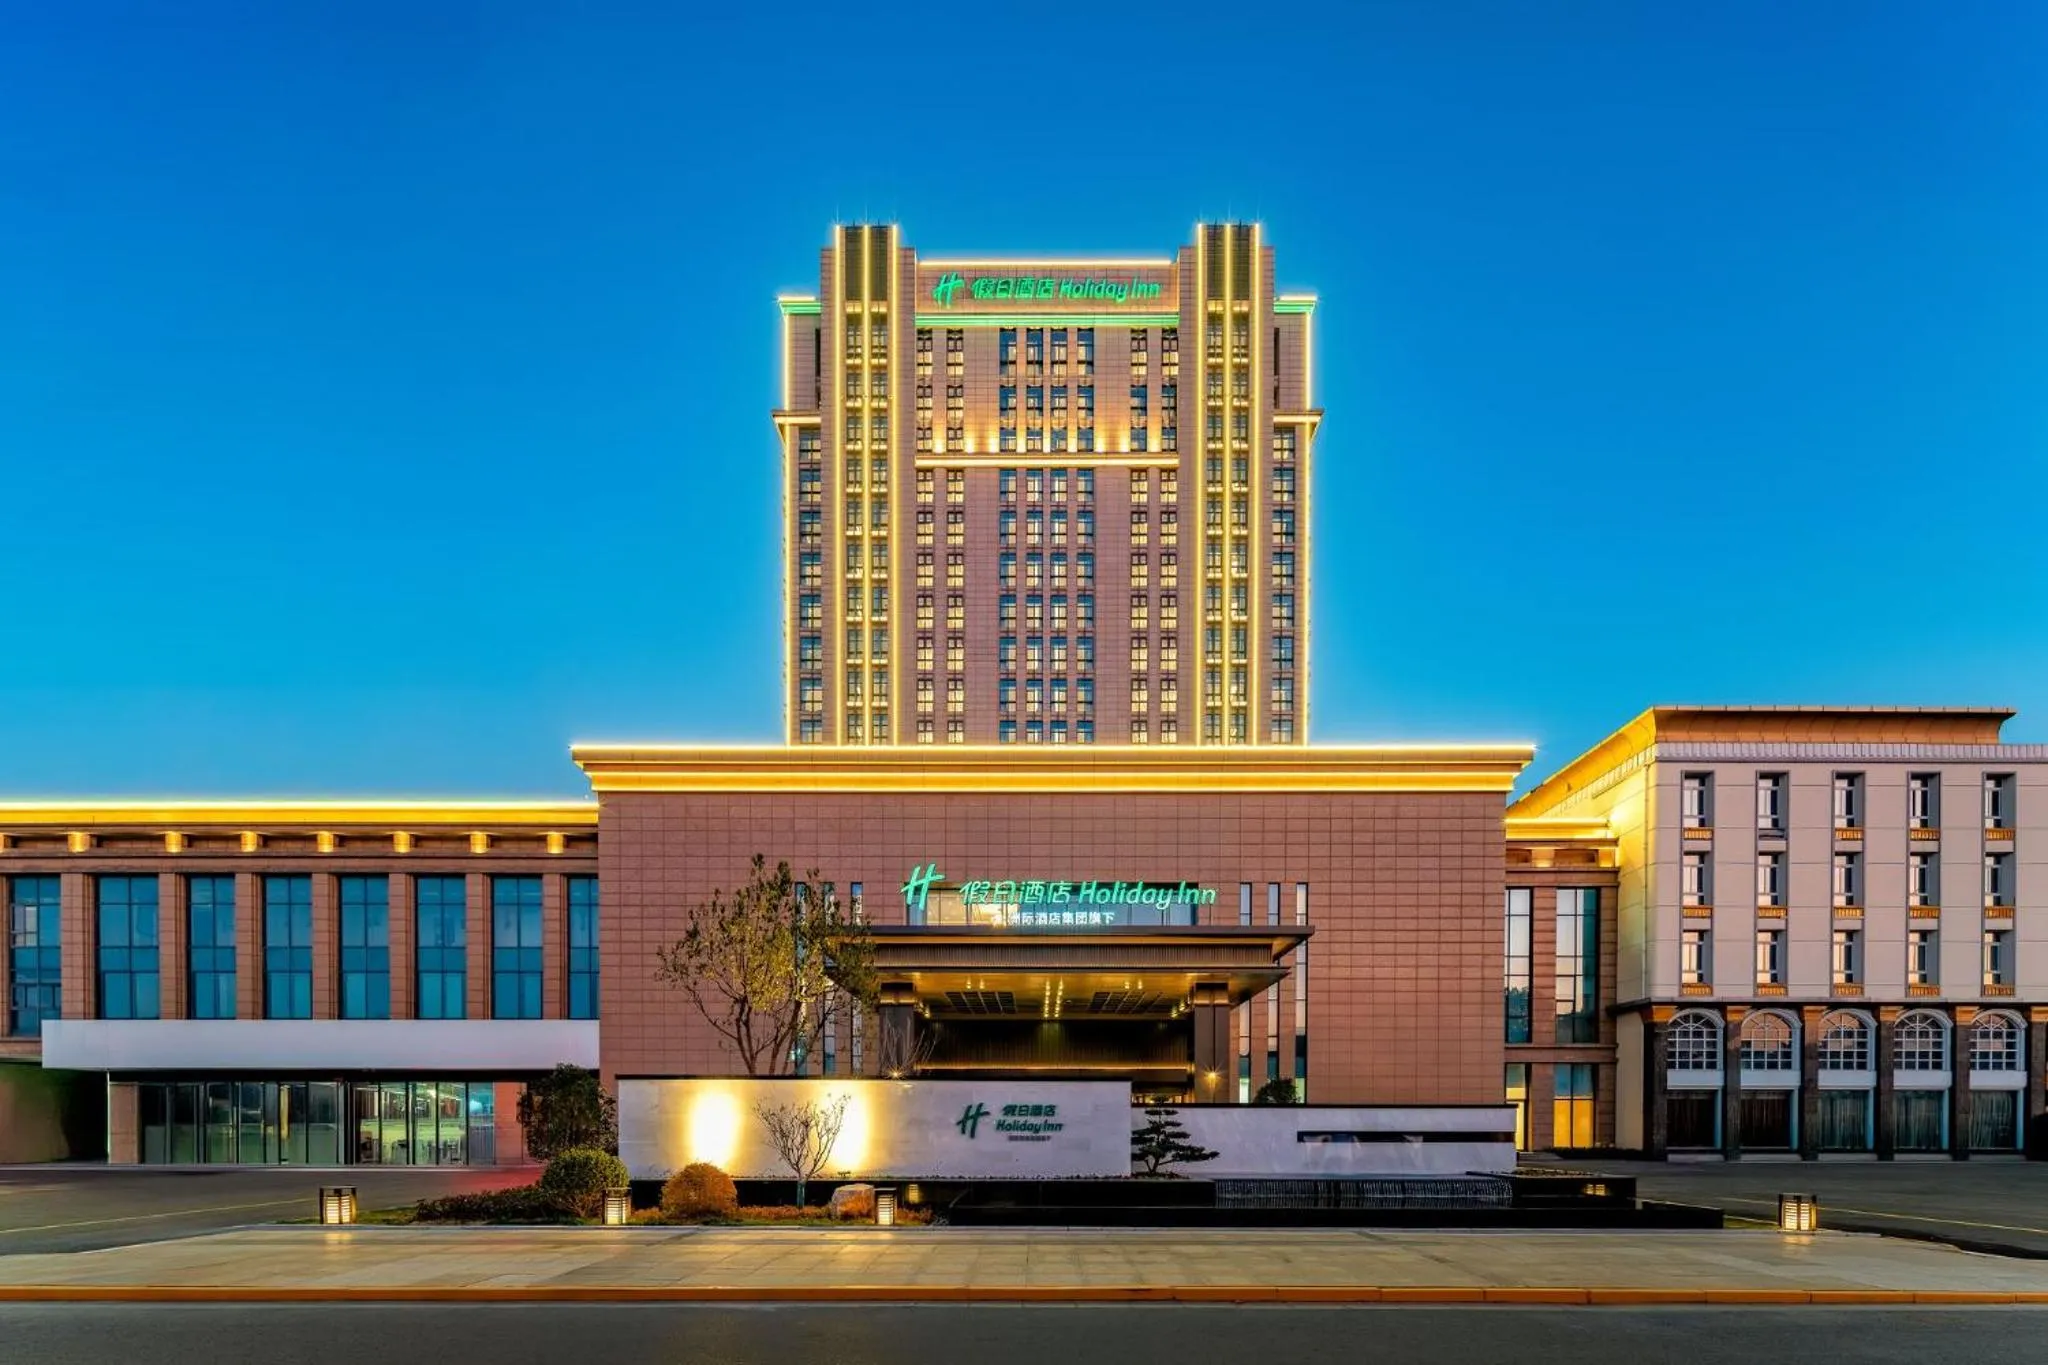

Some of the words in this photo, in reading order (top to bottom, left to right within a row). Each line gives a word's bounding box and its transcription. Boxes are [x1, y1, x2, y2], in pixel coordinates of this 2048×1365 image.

[971, 276, 1055, 299] 假日酒店
[1059, 278, 1128, 303] Holiday
[1131, 277, 1161, 299] Inn
[960, 880, 1072, 905] 假日酒店
[1078, 880, 1173, 910] Holiday
[1178, 880, 1217, 905] Inn
[996, 1119, 1042, 1134] Holiday
[1042, 1119, 1065, 1132] Inn
